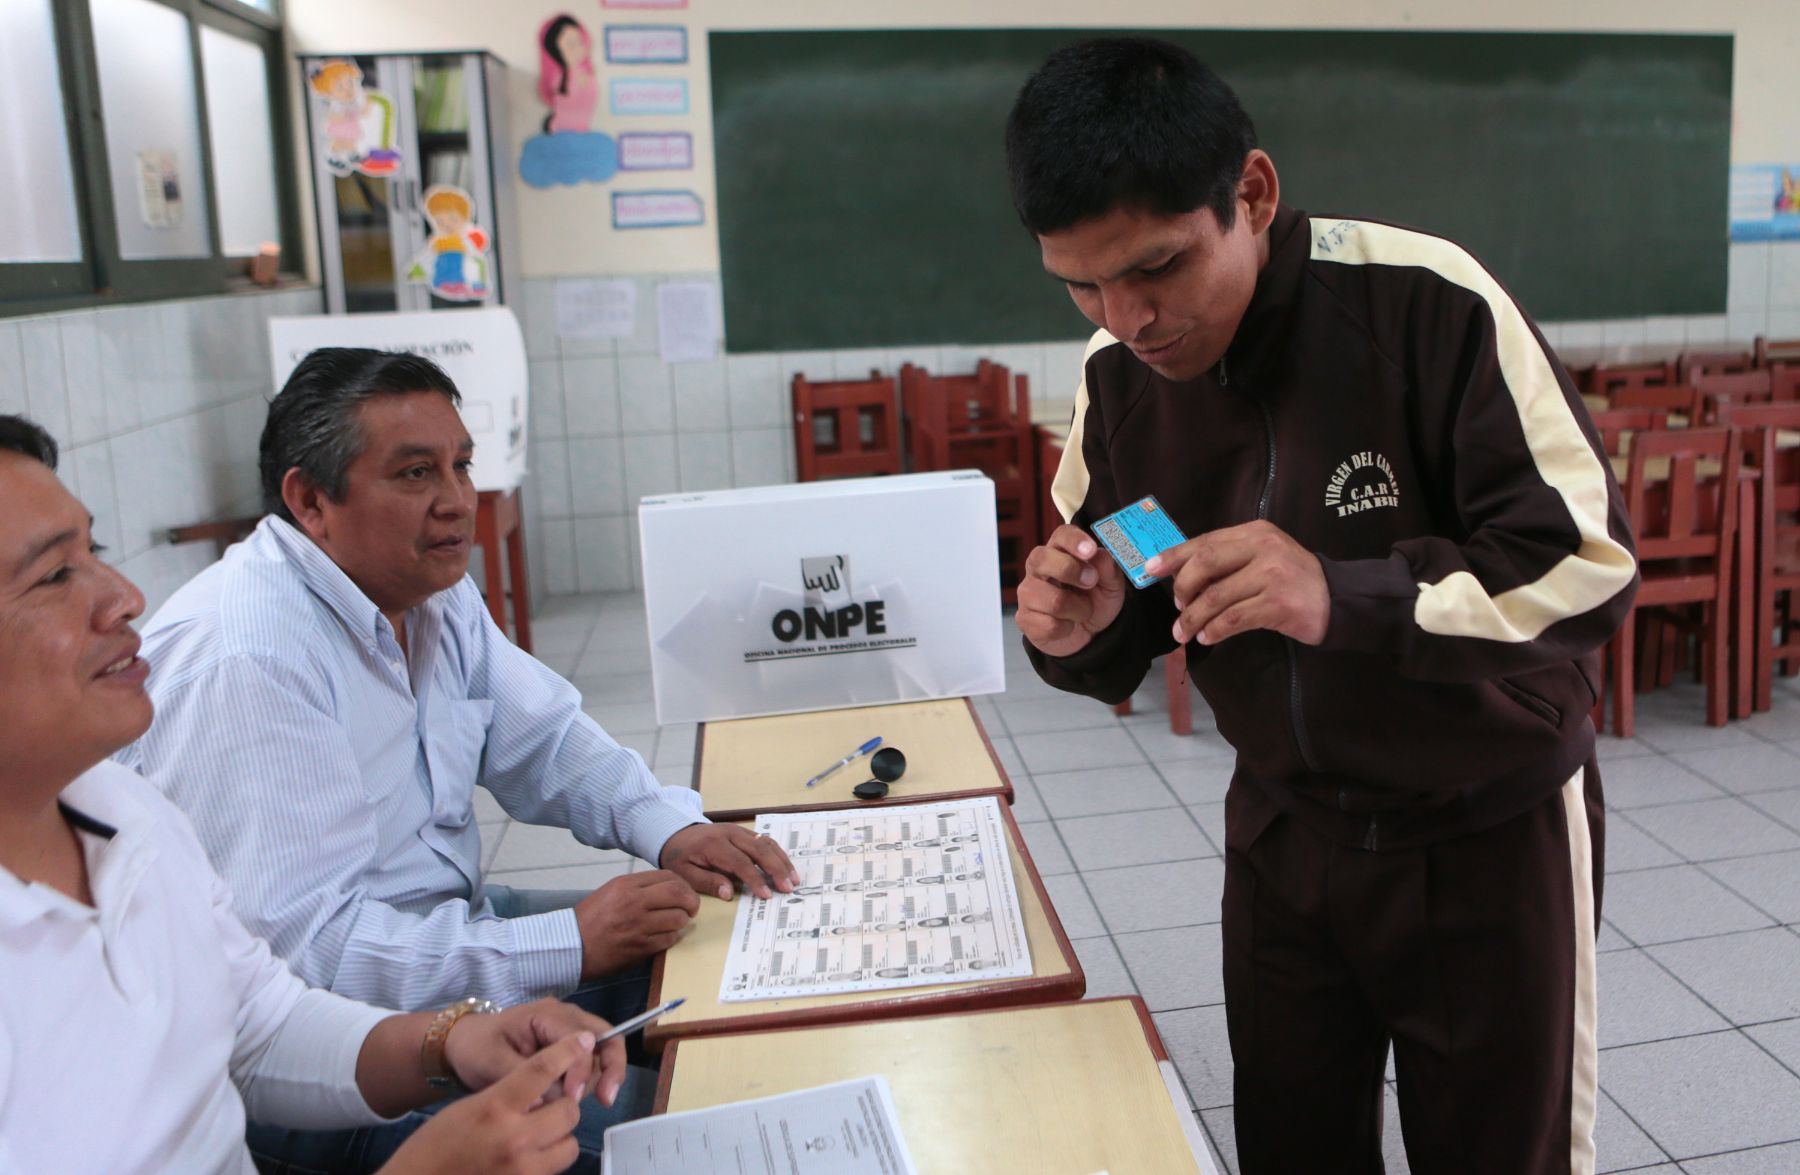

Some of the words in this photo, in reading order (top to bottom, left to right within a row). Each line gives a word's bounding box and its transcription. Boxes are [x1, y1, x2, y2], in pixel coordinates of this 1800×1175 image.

[1325, 461, 1352, 506] VIRGEN
[1351, 452, 1374, 470] DEL
[1376, 453, 1400, 496] CARMEN
[1337, 496, 1399, 517] INABIF
[772, 600, 886, 643] ONPE
[744, 650, 775, 658] OFICINA
[777, 647, 815, 655] NACIONAL
[830, 641, 867, 650] PROCESOS
[869, 637, 917, 647] ELECTORALES
